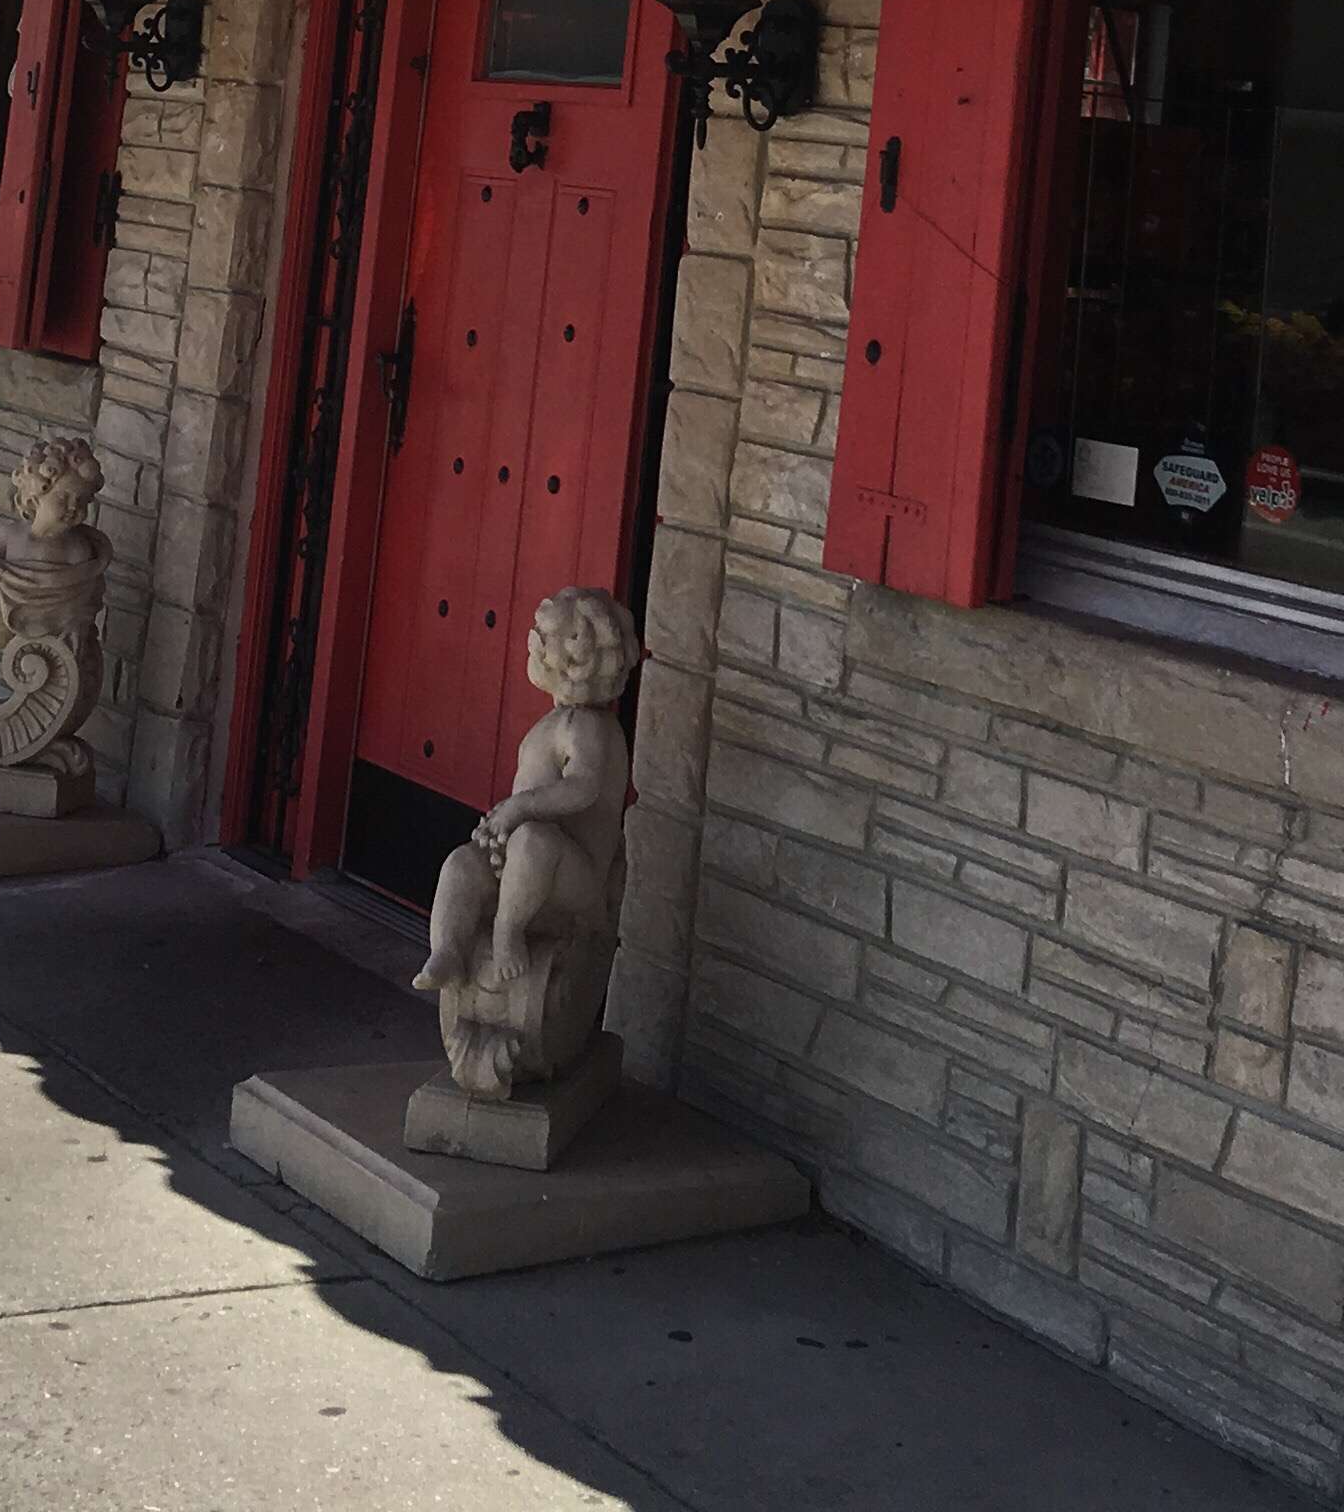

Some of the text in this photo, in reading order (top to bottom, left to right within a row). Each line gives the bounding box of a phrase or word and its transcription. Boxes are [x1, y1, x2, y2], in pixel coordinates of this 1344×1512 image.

[1161, 460, 1219, 484] SAFEGUARD
[1168, 476, 1210, 494] AMERICA
[1248, 485, 1282, 511] yelp
